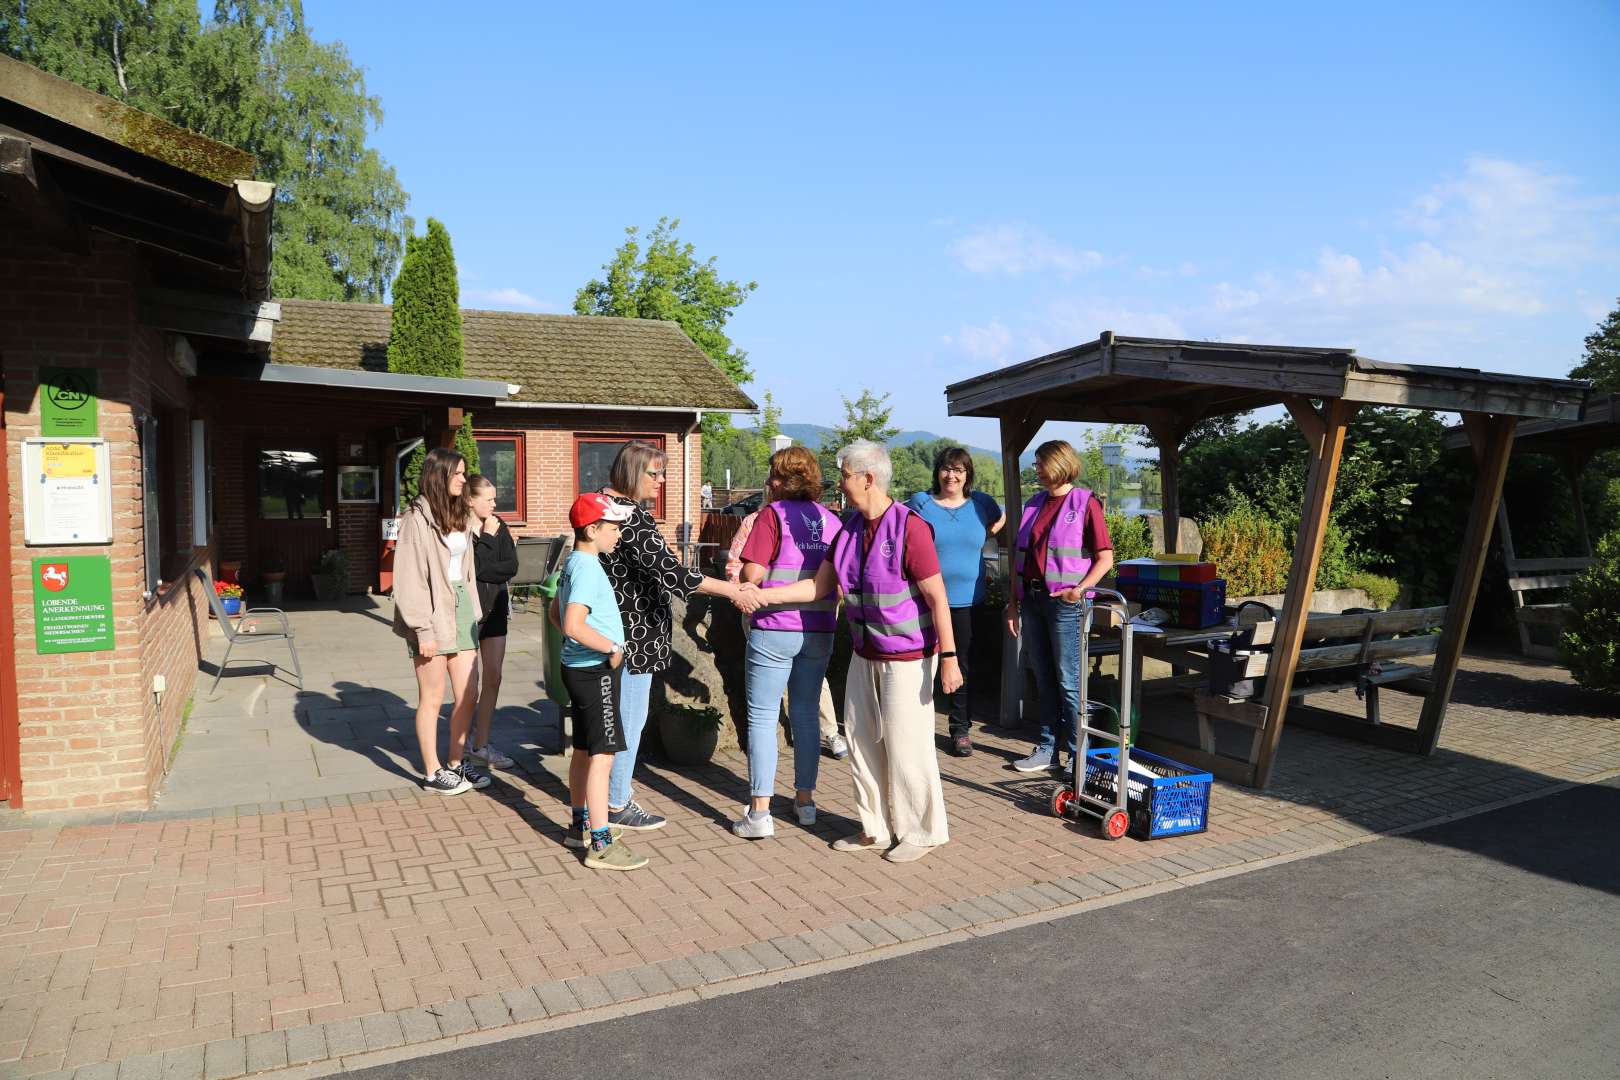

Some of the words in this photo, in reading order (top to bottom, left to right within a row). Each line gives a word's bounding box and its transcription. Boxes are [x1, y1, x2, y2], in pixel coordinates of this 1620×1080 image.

[42, 598, 78, 606] LOBENDE
[42, 604, 104, 613] ANERKENNUNG
[601, 676, 616, 745] FORWARD
